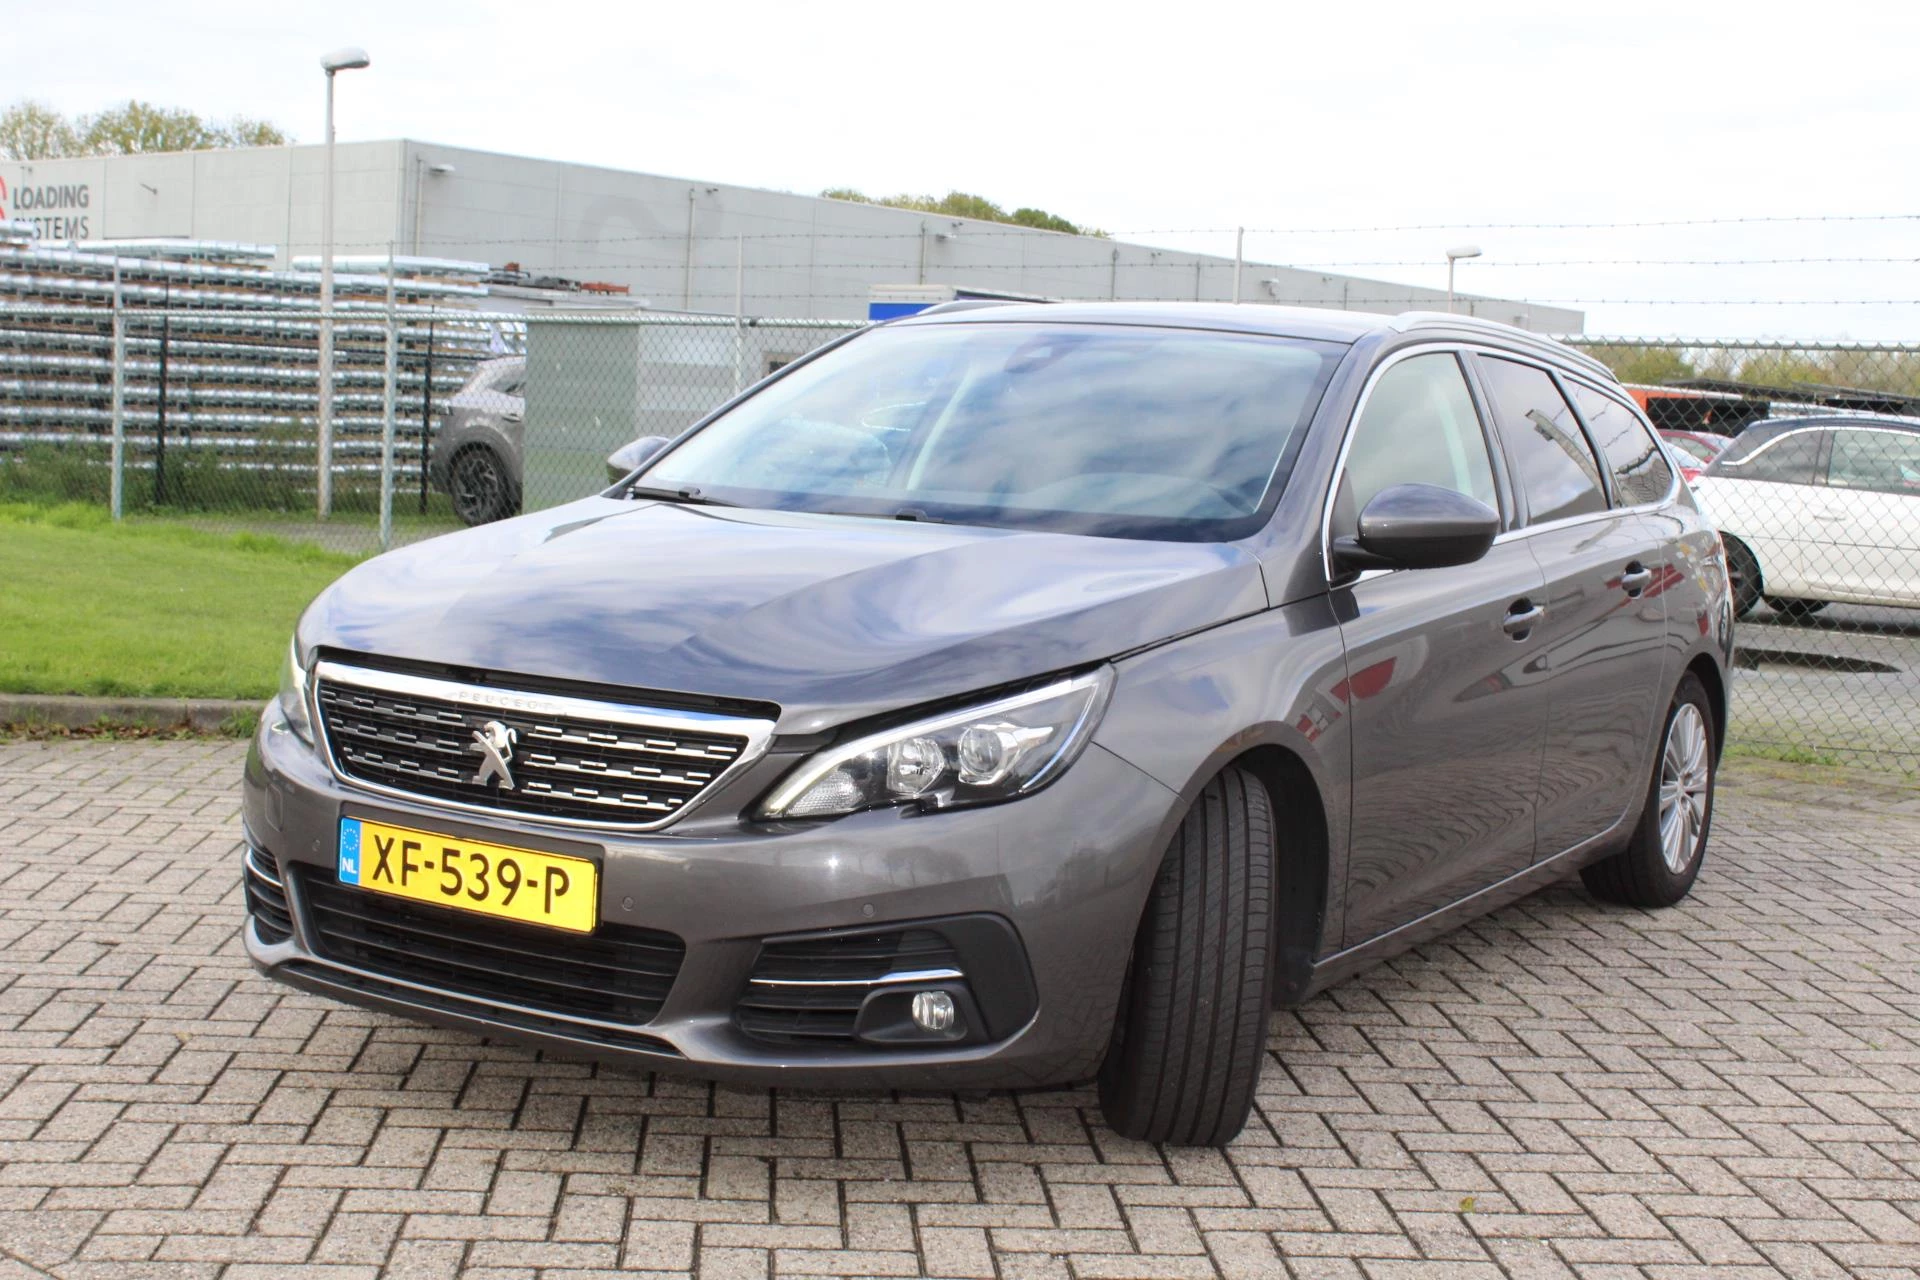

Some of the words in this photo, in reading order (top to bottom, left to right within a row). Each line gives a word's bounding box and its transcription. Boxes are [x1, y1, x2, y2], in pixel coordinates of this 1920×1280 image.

[13, 185, 89, 210] LOADING
[14, 217, 89, 240] STEMS
[341, 857, 357, 874] NL
[372, 834, 570, 914] XF-539-P
